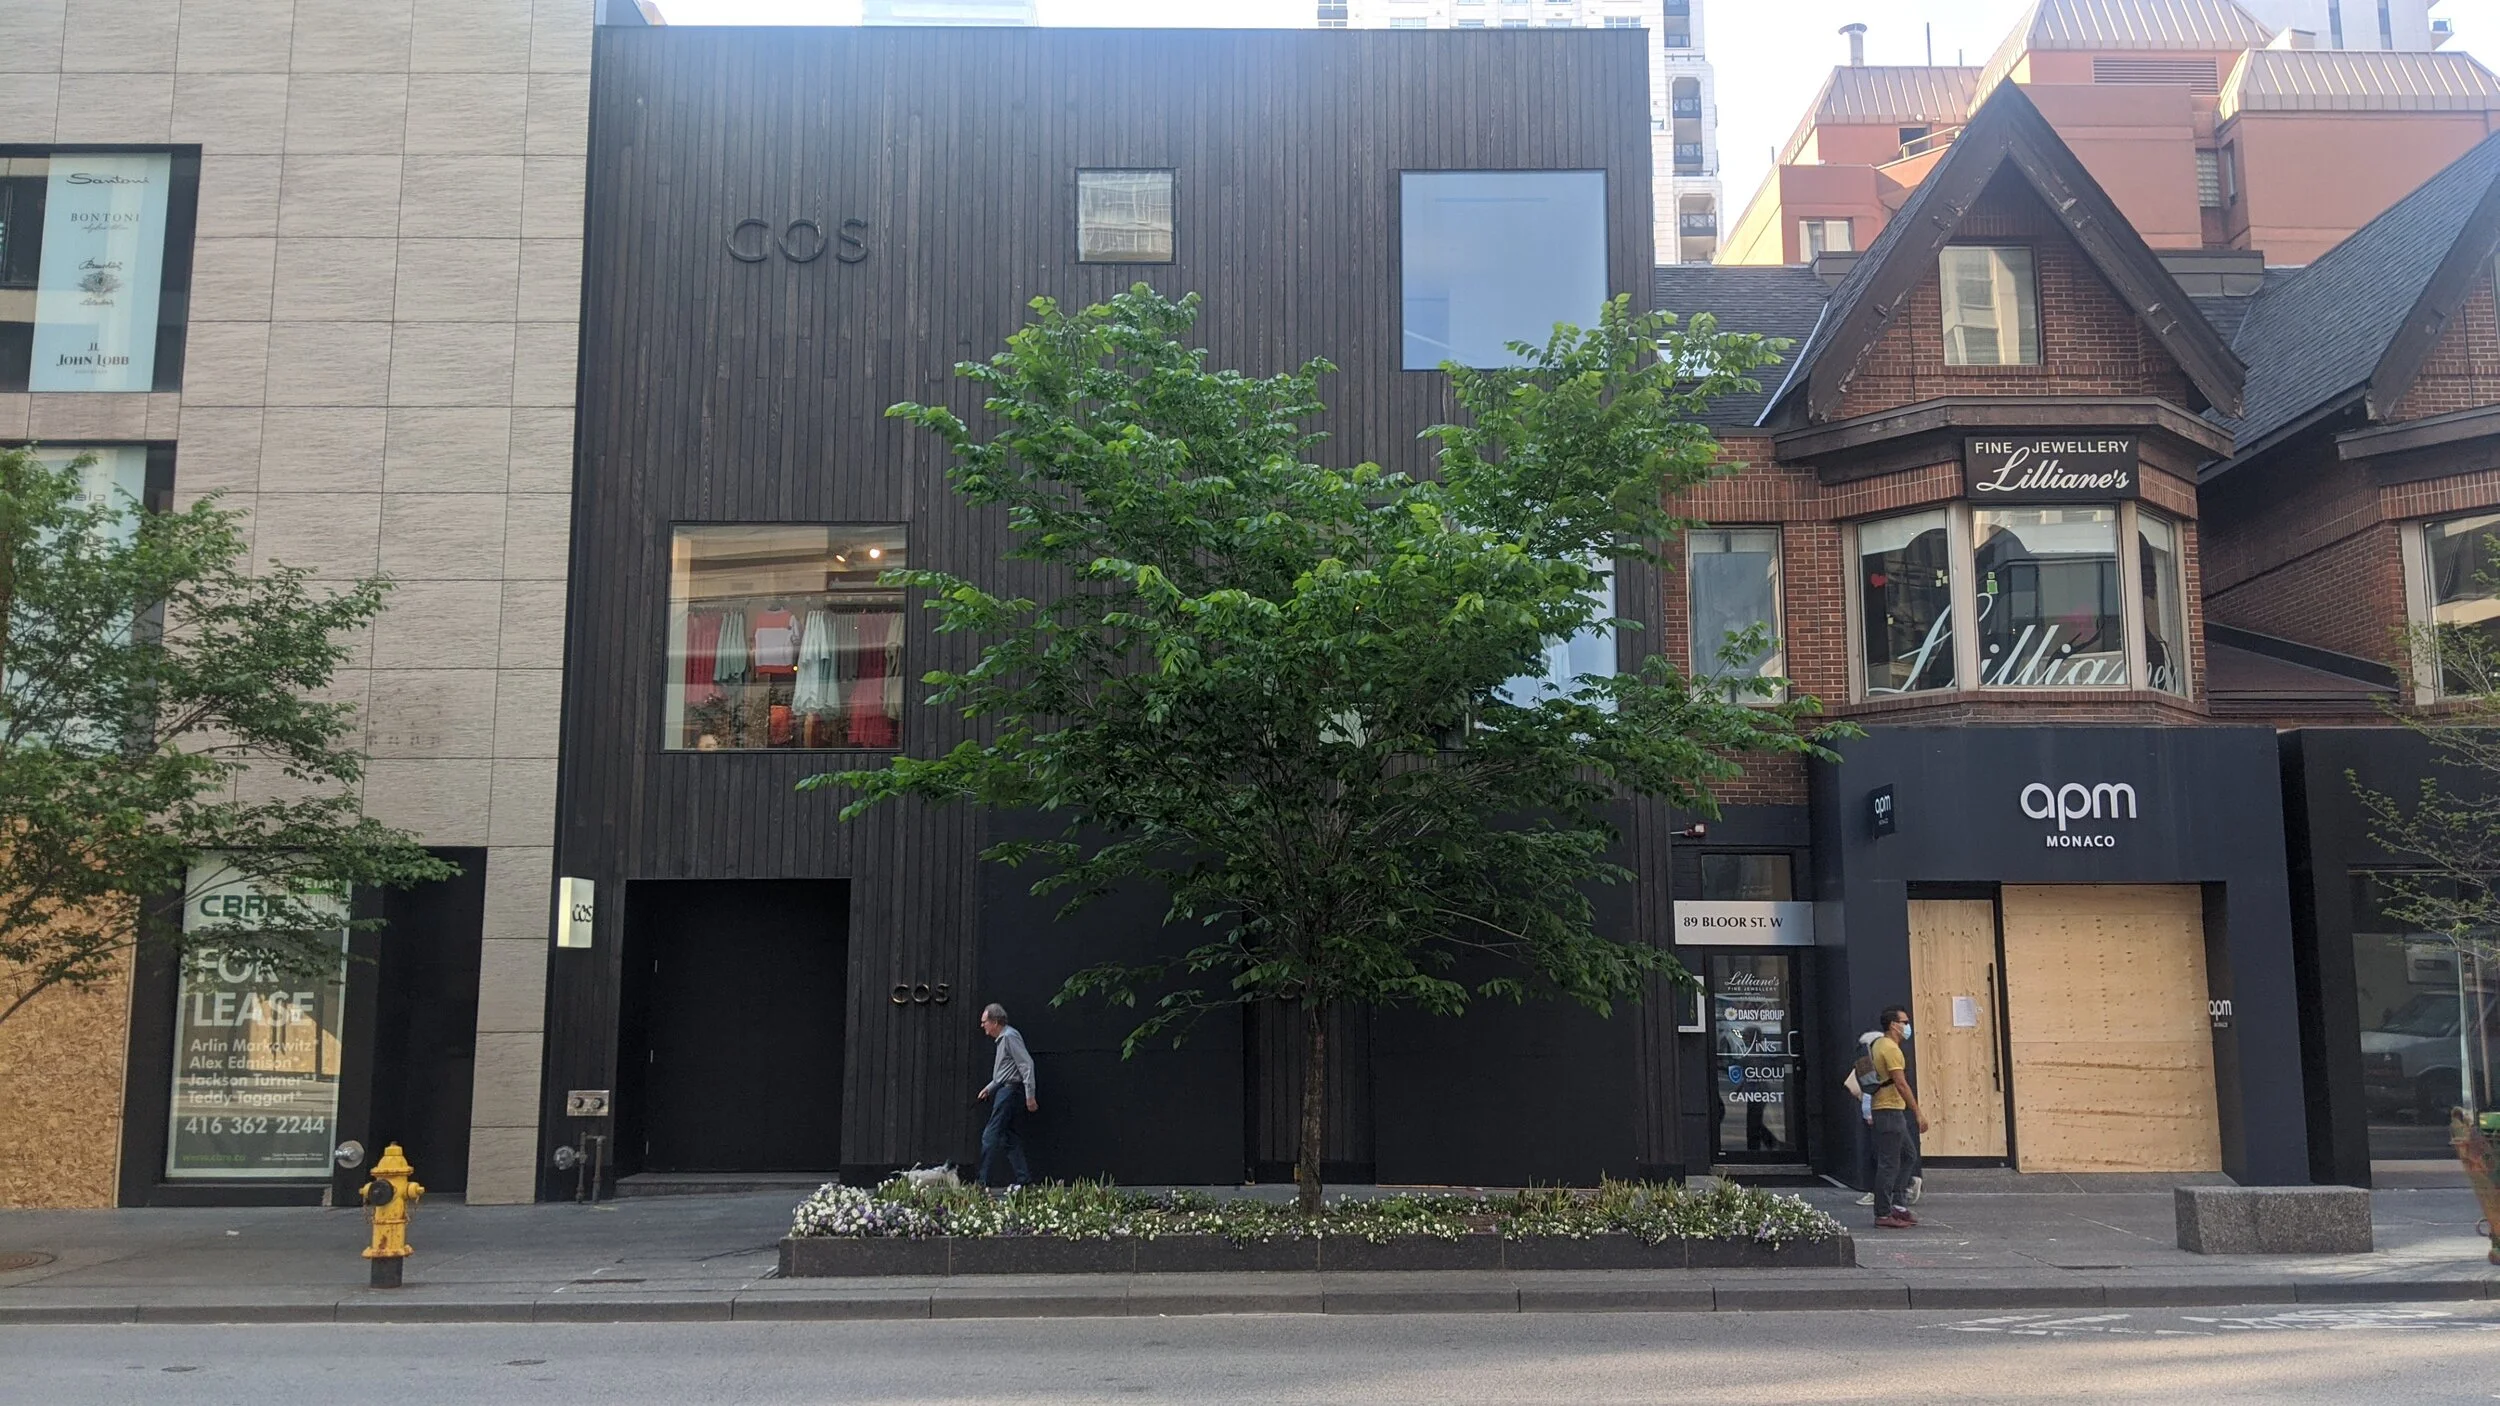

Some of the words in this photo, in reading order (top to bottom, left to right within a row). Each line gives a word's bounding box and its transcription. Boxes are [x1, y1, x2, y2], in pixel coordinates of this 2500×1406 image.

[66, 173, 150, 185] Santoni
[70, 213, 140, 222] BONTONI
[726, 218, 869, 263] COS
[56, 354, 93, 367] JOHN
[97, 354, 130, 368] LOBB
[1975, 442, 2013, 454] FINE
[2031, 441, 2129, 454] JEWELLERY
[1976, 446, 2130, 492] Lilliane's
[1874, 794, 1892, 819] apm
[2020, 782, 2137, 831] apm
[2046, 835, 2116, 848] MONACO
[572, 903, 593, 923] COS
[1683, 916, 1698, 928] 89
[1702, 916, 1747, 928] BLOOR
[1750, 916, 1767, 928] ST.
[1770, 917, 1784, 928] W
[197, 948, 280, 984] FOR
[1724, 970, 1780, 986] Lilliane's
[891, 983, 949, 1003] COS
[193, 991, 315, 1027] LEASE
[1738, 1009, 1759, 1020] DAISY
[1760, 1009, 1785, 1020] GROUP
[2208, 1000, 2232, 1021] apm
[190, 1038, 228, 1053] Arlin
[188, 1055, 223, 1070] Alex
[187, 1072, 248, 1087] Jackson
[1744, 1066, 1785, 1079] GLOW
[187, 1089, 233, 1107] Teddy
[184, 1116, 223, 1135] 416
[229, 1116, 268, 1135] 362
[275, 1116, 326, 1135] 2244
